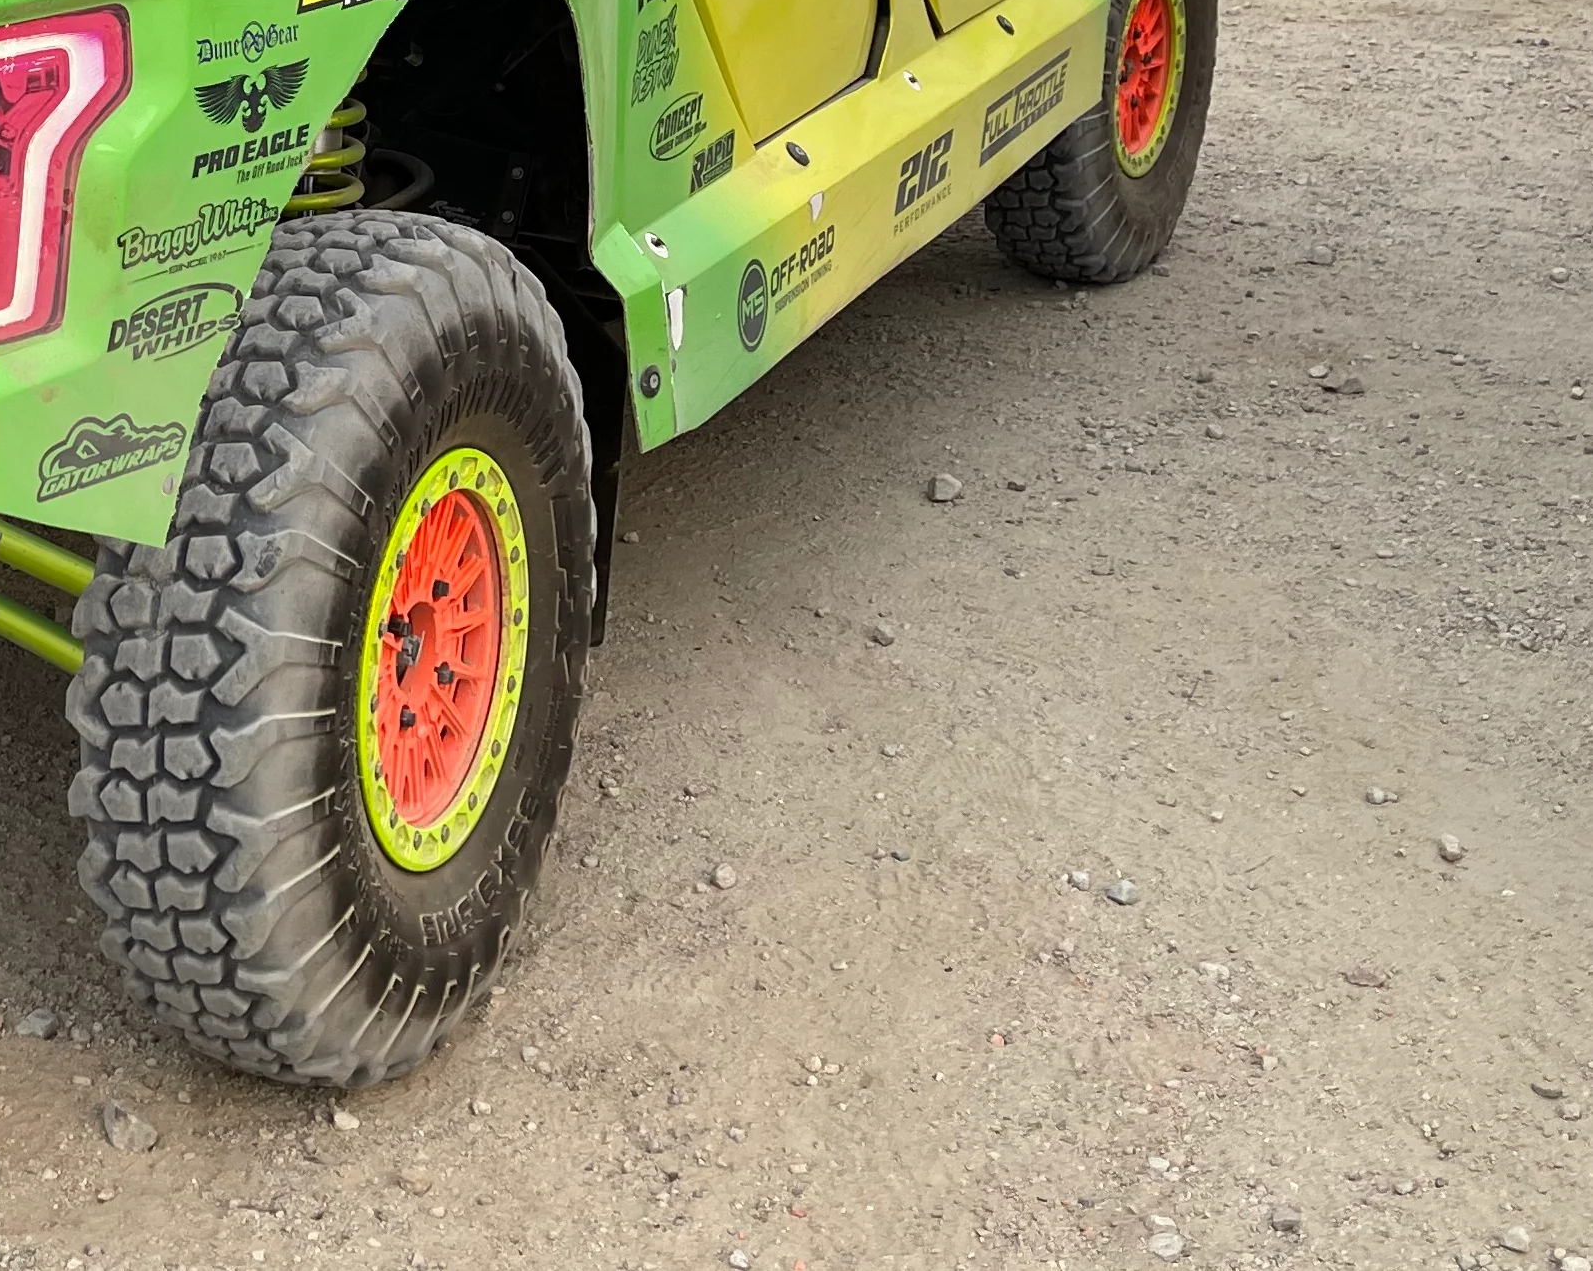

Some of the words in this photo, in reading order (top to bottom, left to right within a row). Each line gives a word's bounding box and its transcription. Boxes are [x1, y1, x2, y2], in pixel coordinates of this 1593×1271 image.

[196, 38, 239, 65] Dune
[266, 23, 299, 48] Gear
[656, 93, 703, 145] CONCEPT
[982, 92, 1011, 149] FULL
[1013, 52, 1070, 124] THROTTLE
[192, 145, 240, 179] PRO
[242, 123, 310, 164] EAGLE
[236, 168, 250, 185] The
[266, 157, 285, 175] Road
[690, 130, 734, 195] RAPID
[895, 129, 954, 216] 212
[893, 182, 952, 237] PERFORMANCE
[169, 257, 208, 274] SINCE
[107, 291, 209, 353] DESERT
[132, 313, 239, 360] WHIPS
[40, 437, 183, 498] GATORWRAPS
